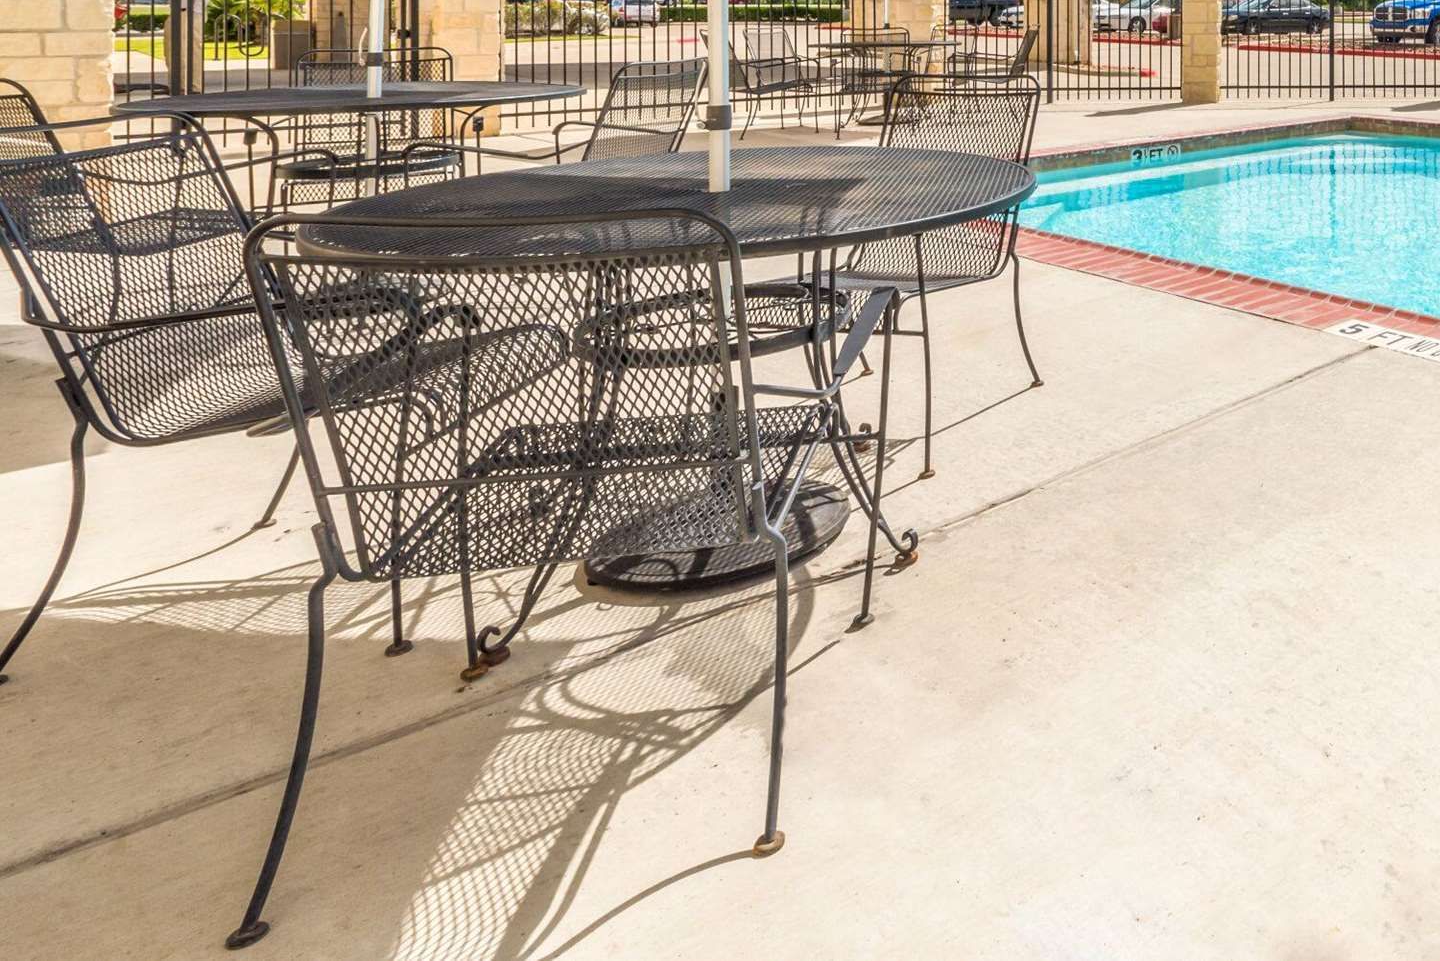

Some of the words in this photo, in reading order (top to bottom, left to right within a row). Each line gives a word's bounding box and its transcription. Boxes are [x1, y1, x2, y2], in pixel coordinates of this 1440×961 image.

[1339, 323, 1369, 335] 5
[1367, 330, 1415, 346] FT
[1407, 339, 1434, 353] NO
